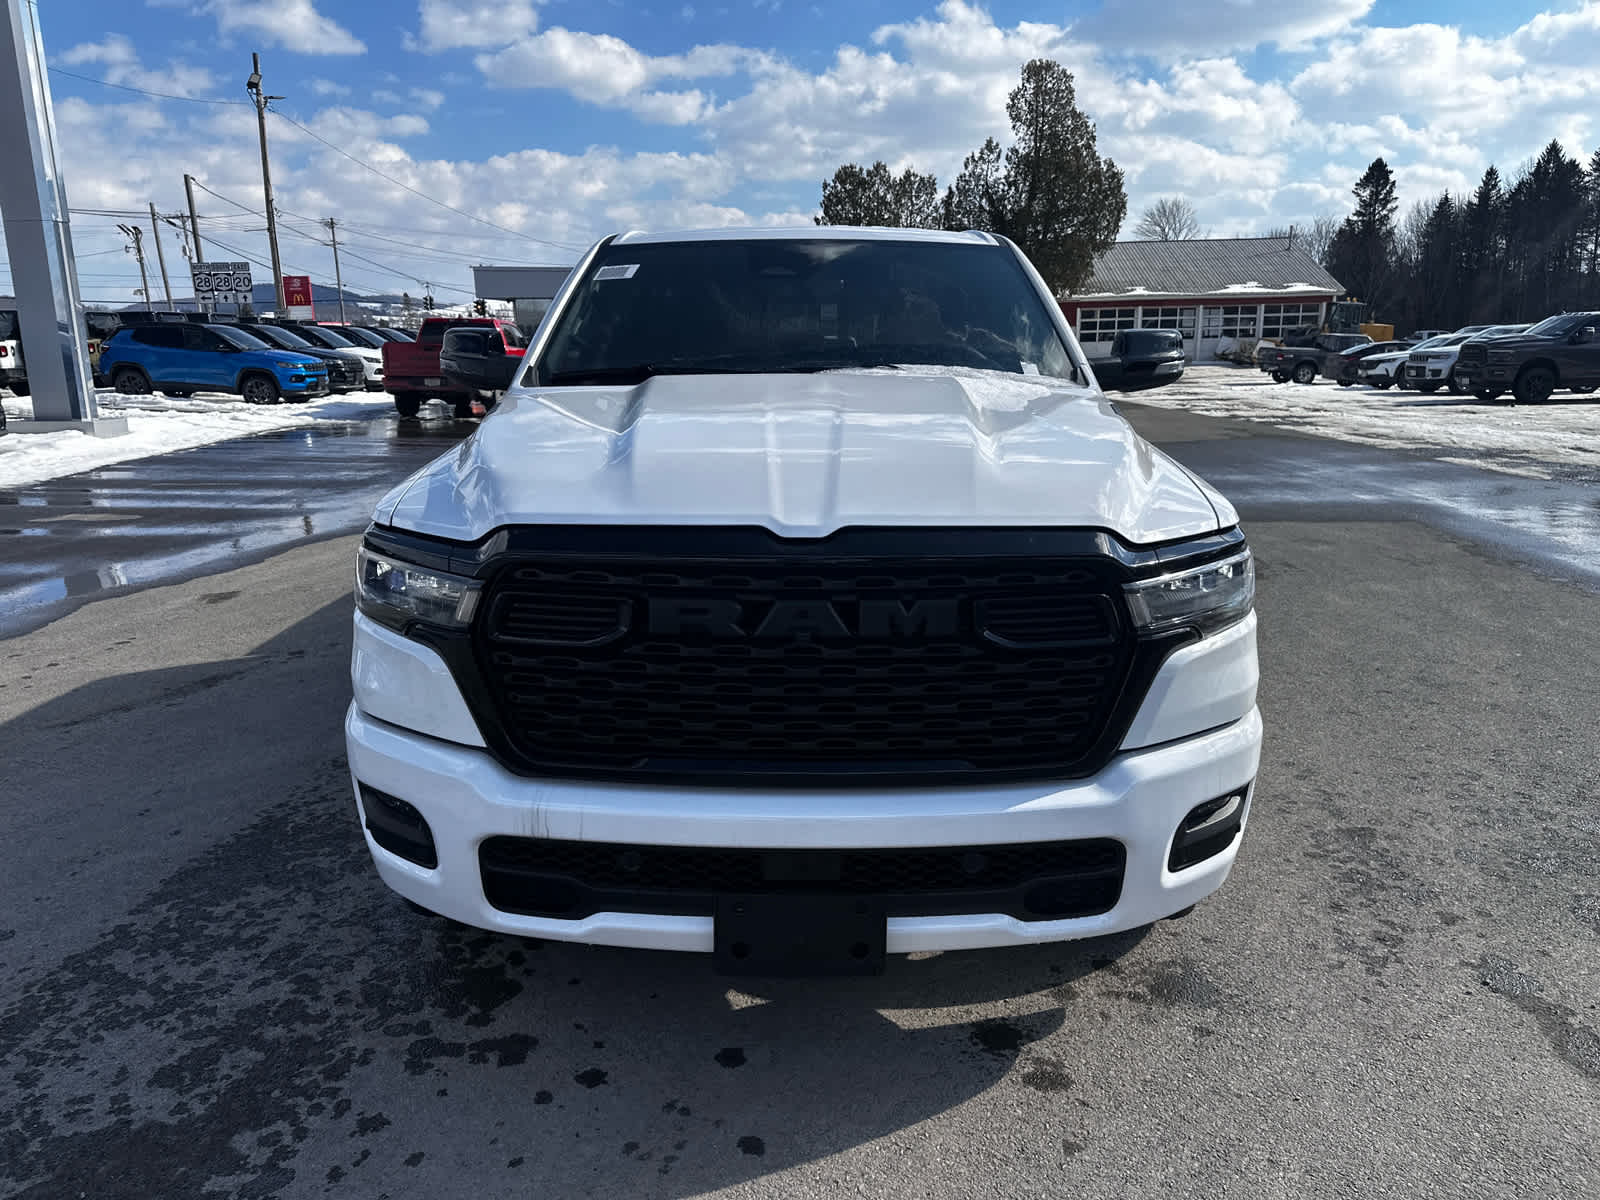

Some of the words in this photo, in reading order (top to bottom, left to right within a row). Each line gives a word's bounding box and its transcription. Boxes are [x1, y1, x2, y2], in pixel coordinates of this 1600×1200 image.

[196, 277, 211, 288] 28
[216, 277, 230, 288] 28
[235, 277, 250, 288] 20
[648, 598, 959, 637] RAM
